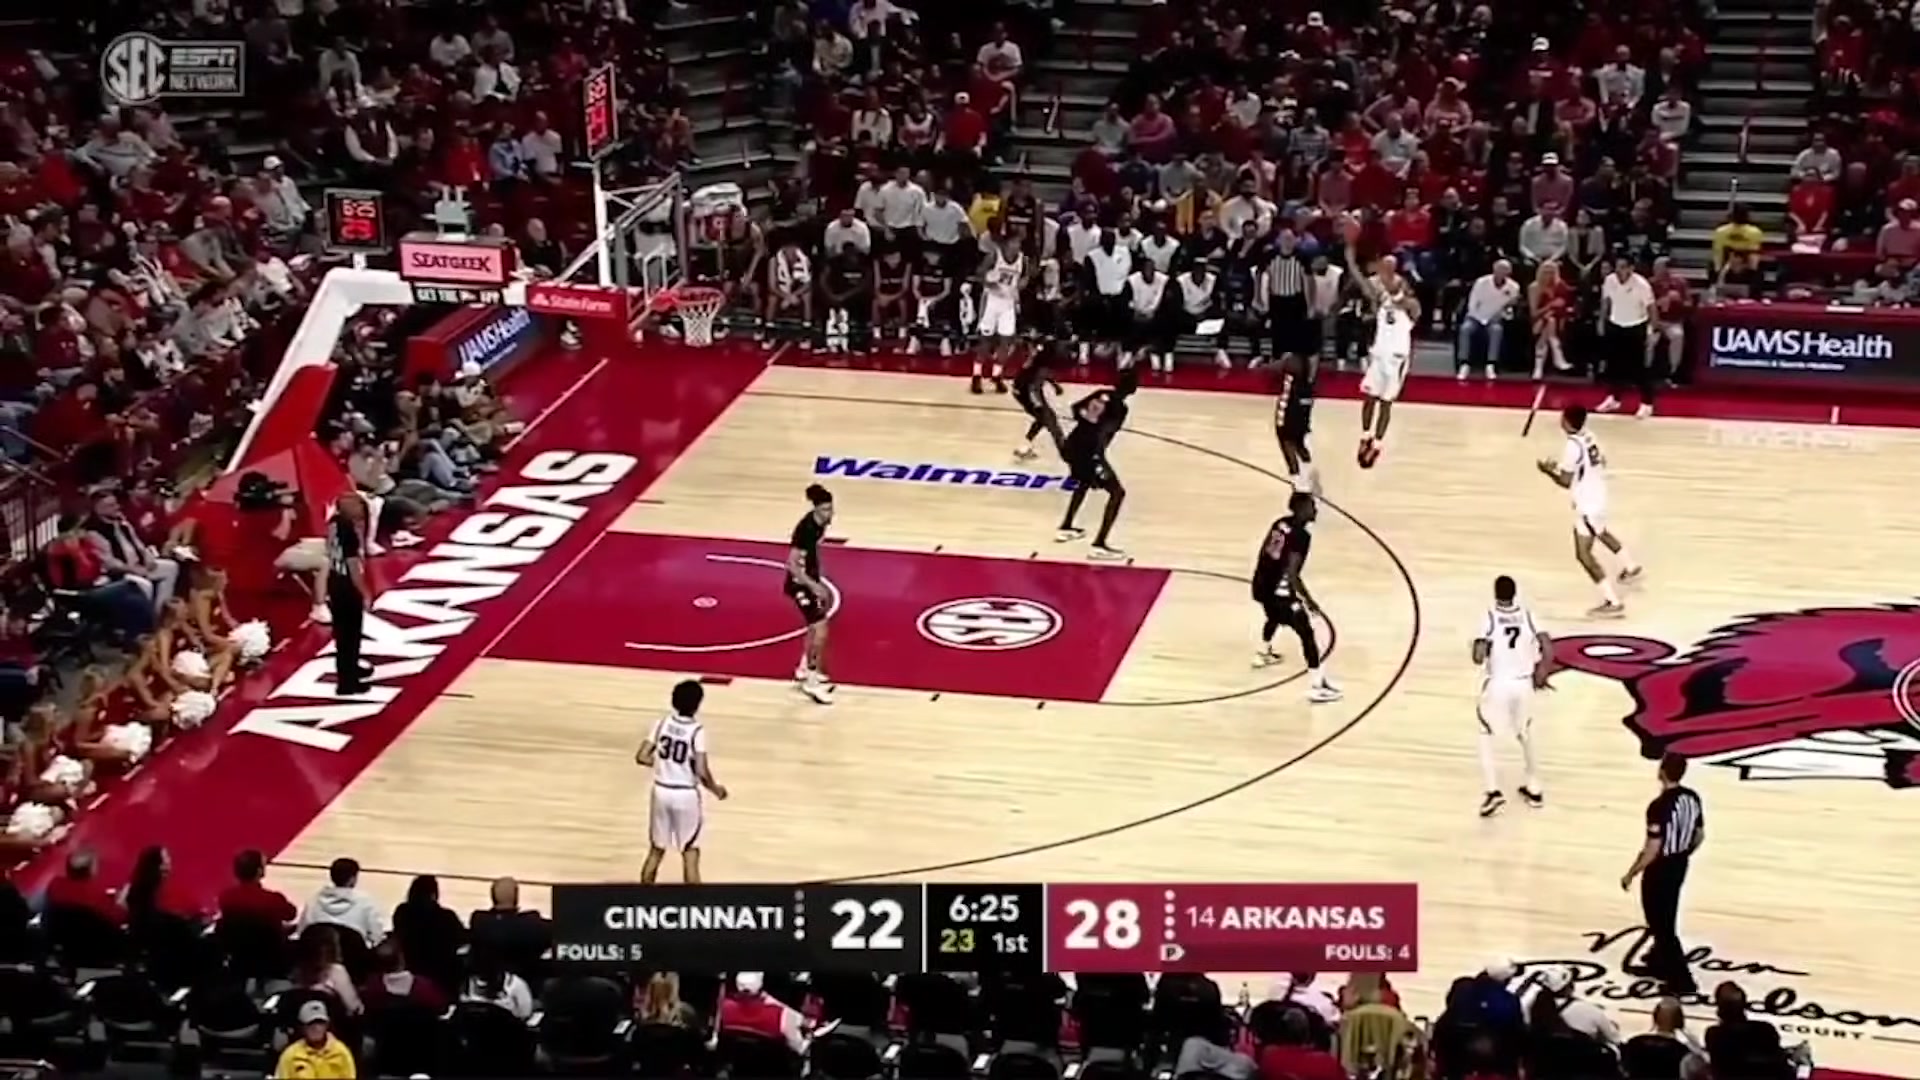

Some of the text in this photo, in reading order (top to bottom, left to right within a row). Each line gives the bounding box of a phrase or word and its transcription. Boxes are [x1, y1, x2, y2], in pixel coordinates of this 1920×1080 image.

[411, 252, 492, 273] SEATGEEK
[1504, 626, 1521, 649] 7
[659, 735, 688, 764] 30
[1780, 1023, 1865, 1041] COURT
